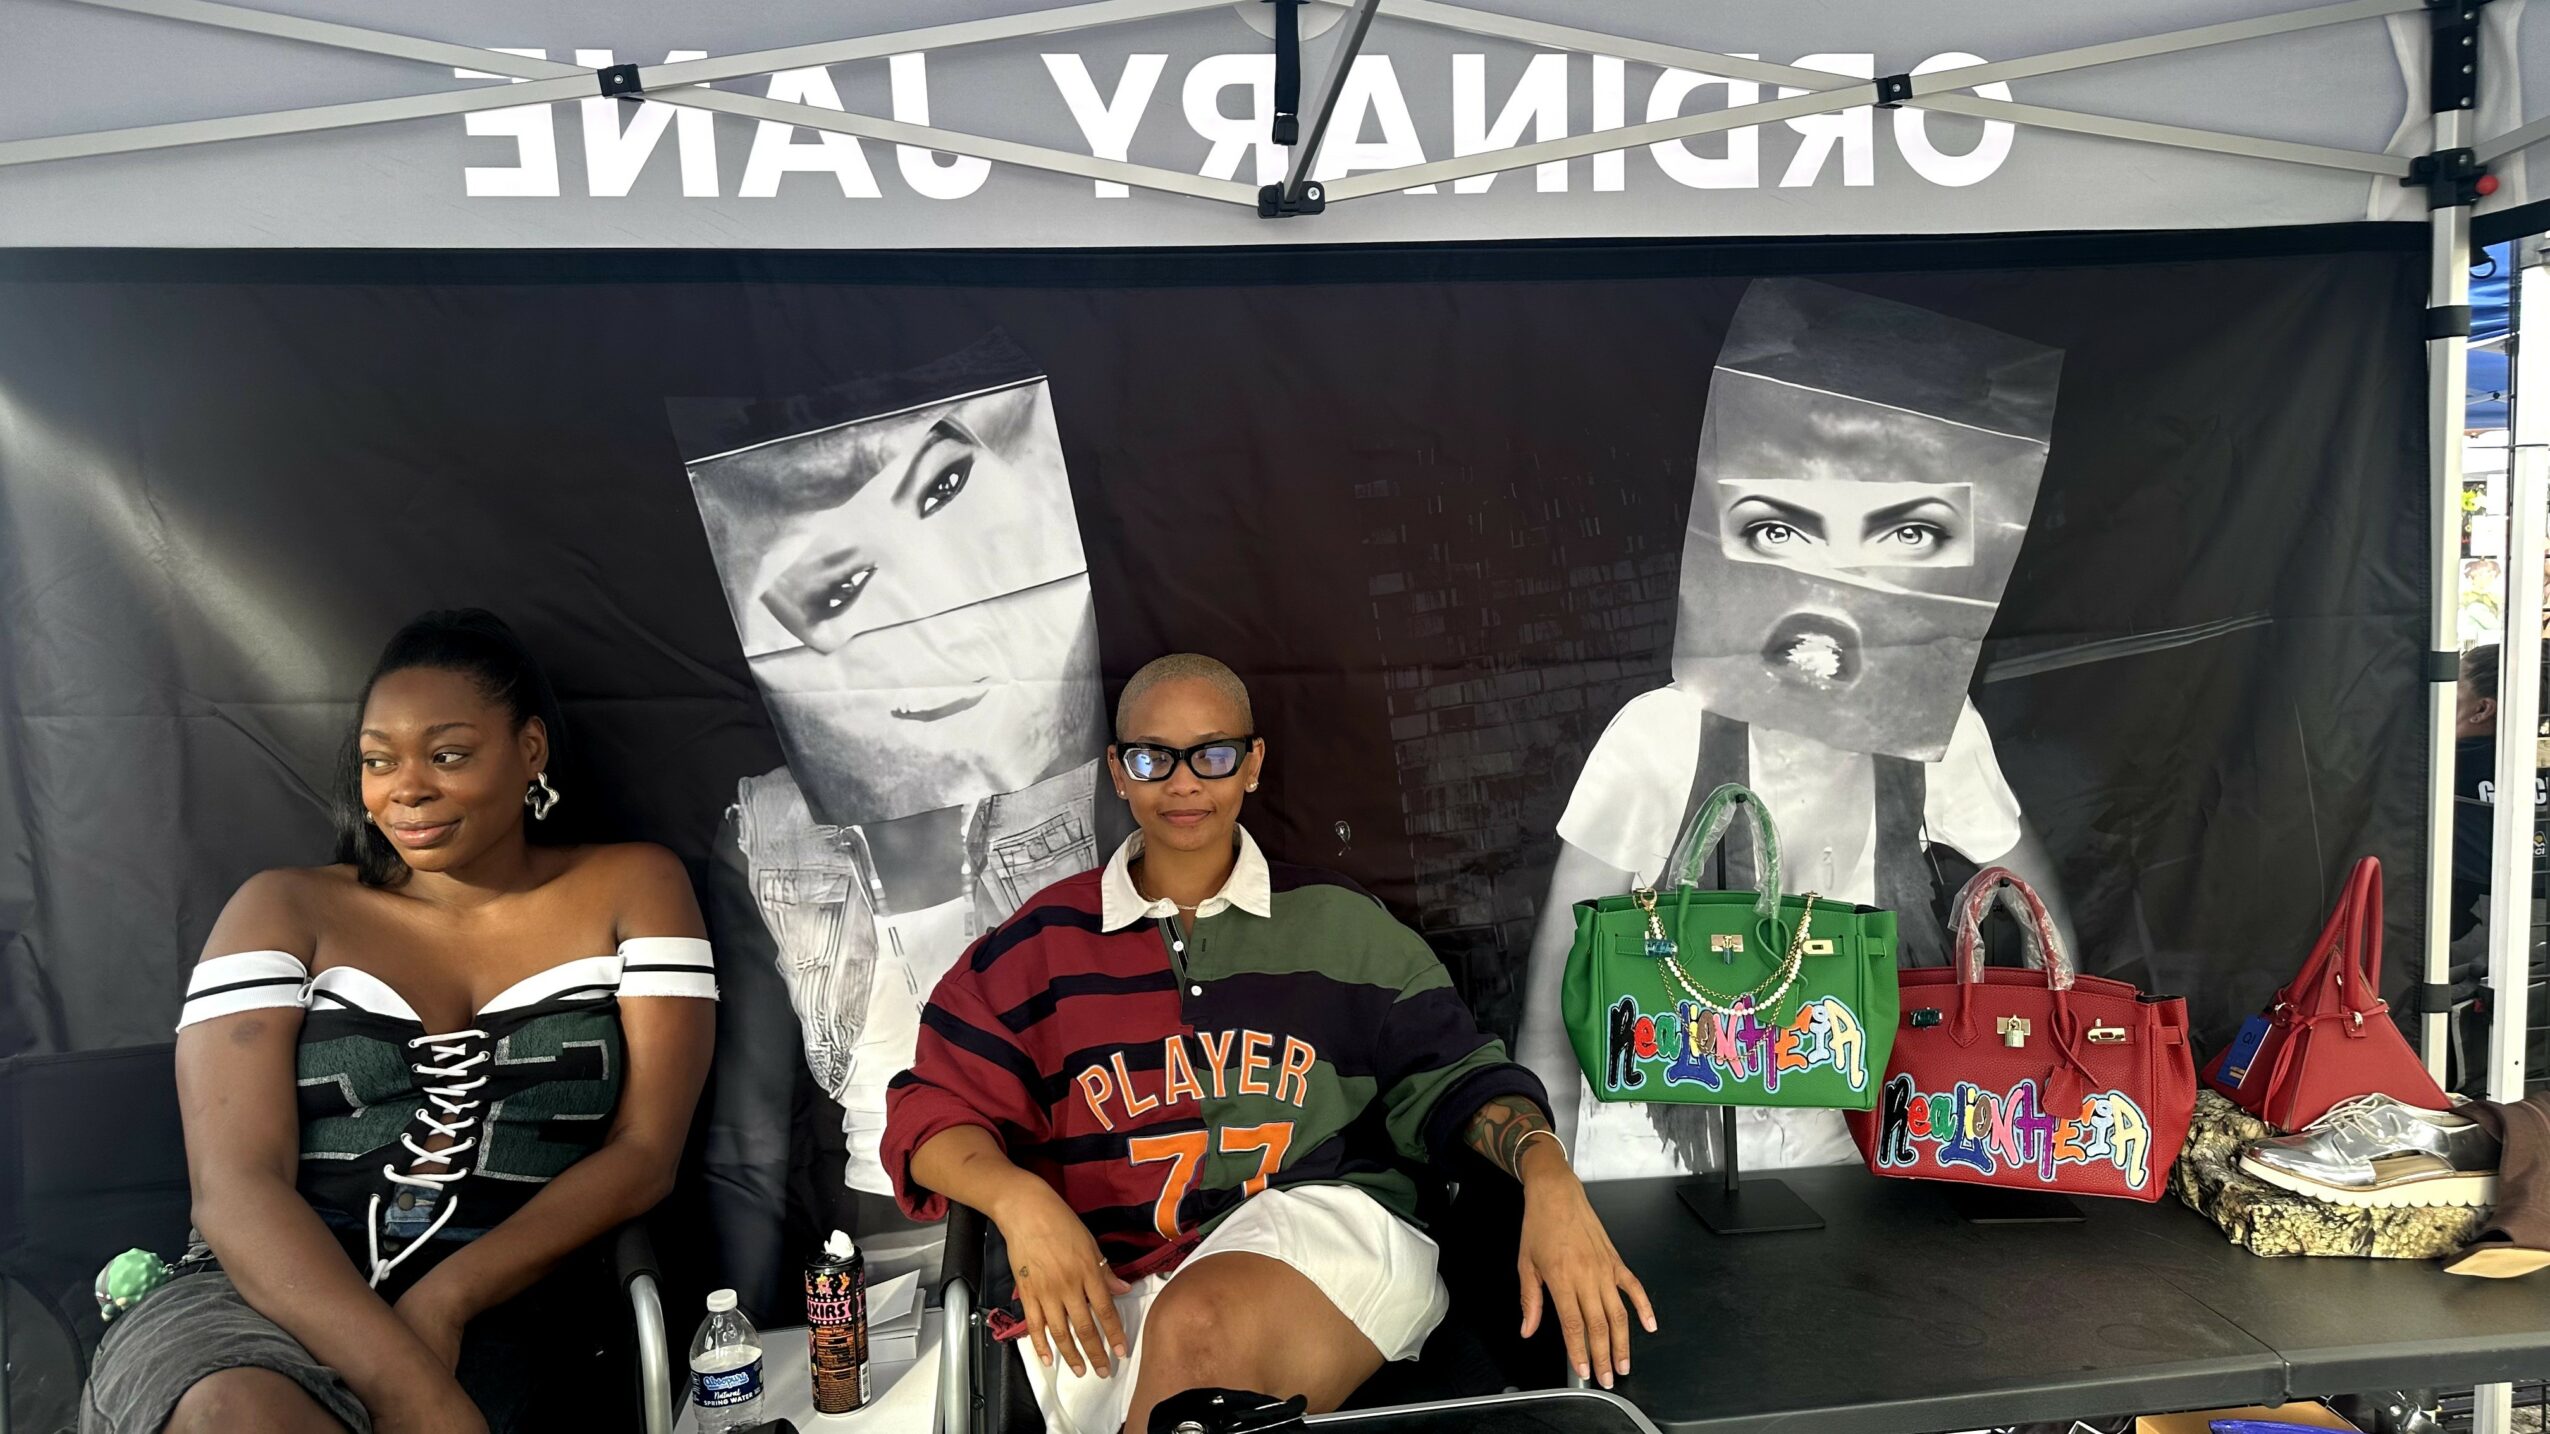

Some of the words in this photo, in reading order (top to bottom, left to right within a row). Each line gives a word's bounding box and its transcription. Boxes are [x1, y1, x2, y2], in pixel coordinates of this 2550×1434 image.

[1075, 1028, 1316, 1131] PLAYER
[1127, 1120, 1296, 1242] 77
[713, 1388, 741, 1400] Natural
[730, 1392, 753, 1403] WATER
